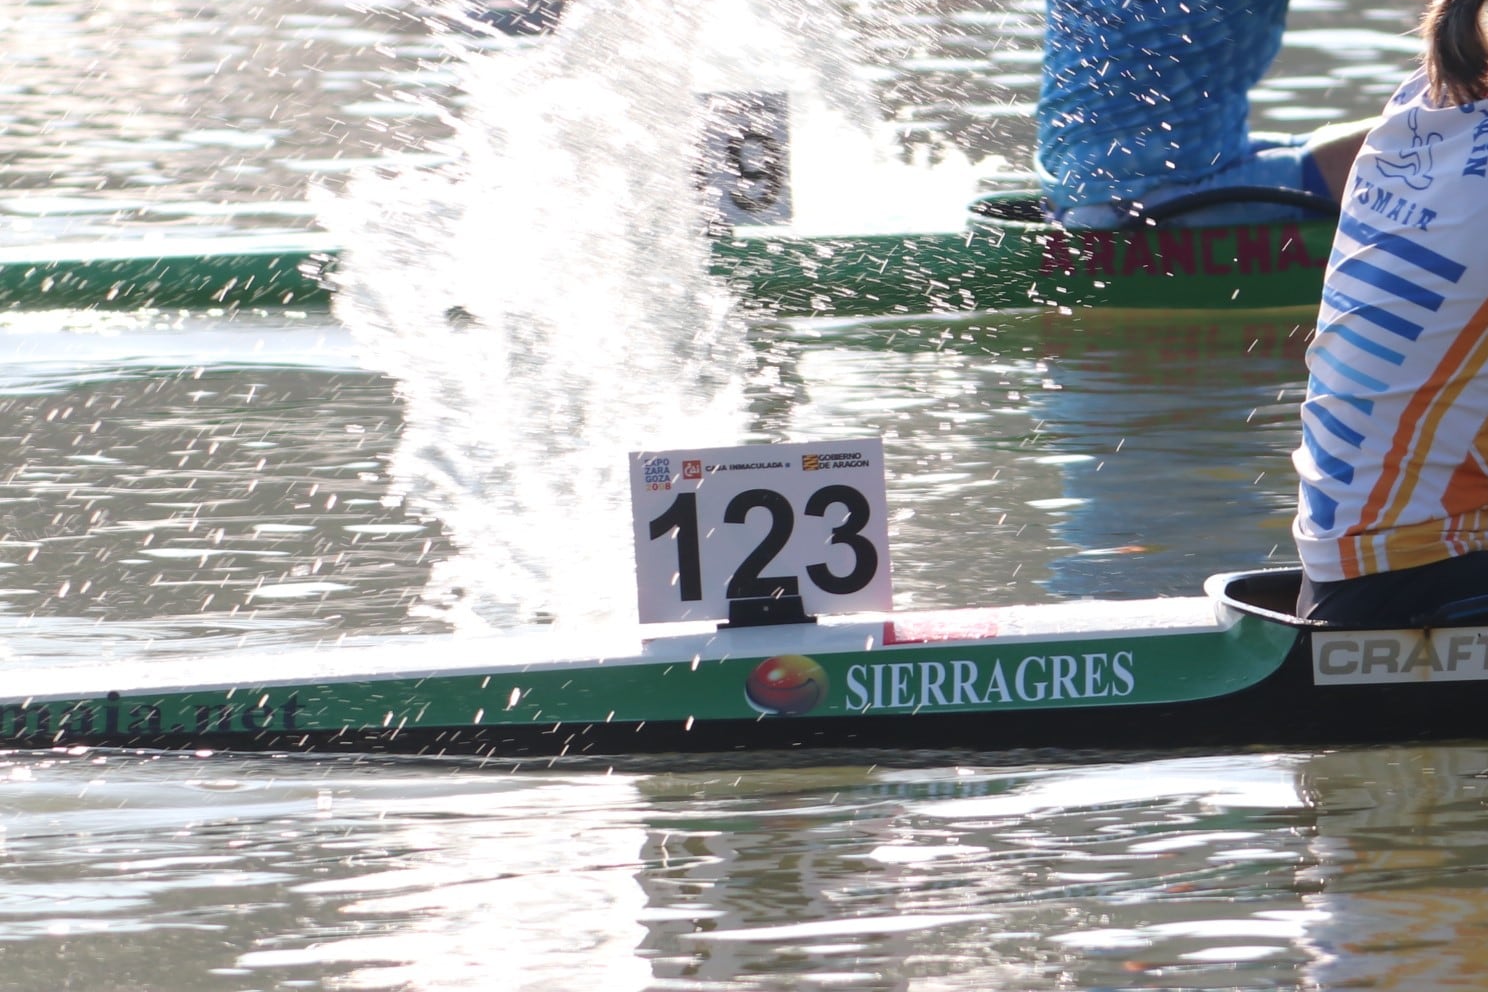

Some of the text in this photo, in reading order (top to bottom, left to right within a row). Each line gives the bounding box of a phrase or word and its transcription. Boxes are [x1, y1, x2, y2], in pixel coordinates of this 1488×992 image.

[818, 452, 862, 460] GOBIERNO
[729, 461, 783, 470] INMACULADA
[645, 467, 670, 475] ZARA
[645, 475, 671, 483] GOZA
[648, 485, 879, 602] 123
[845, 651, 1135, 711] SIERRAGRES
